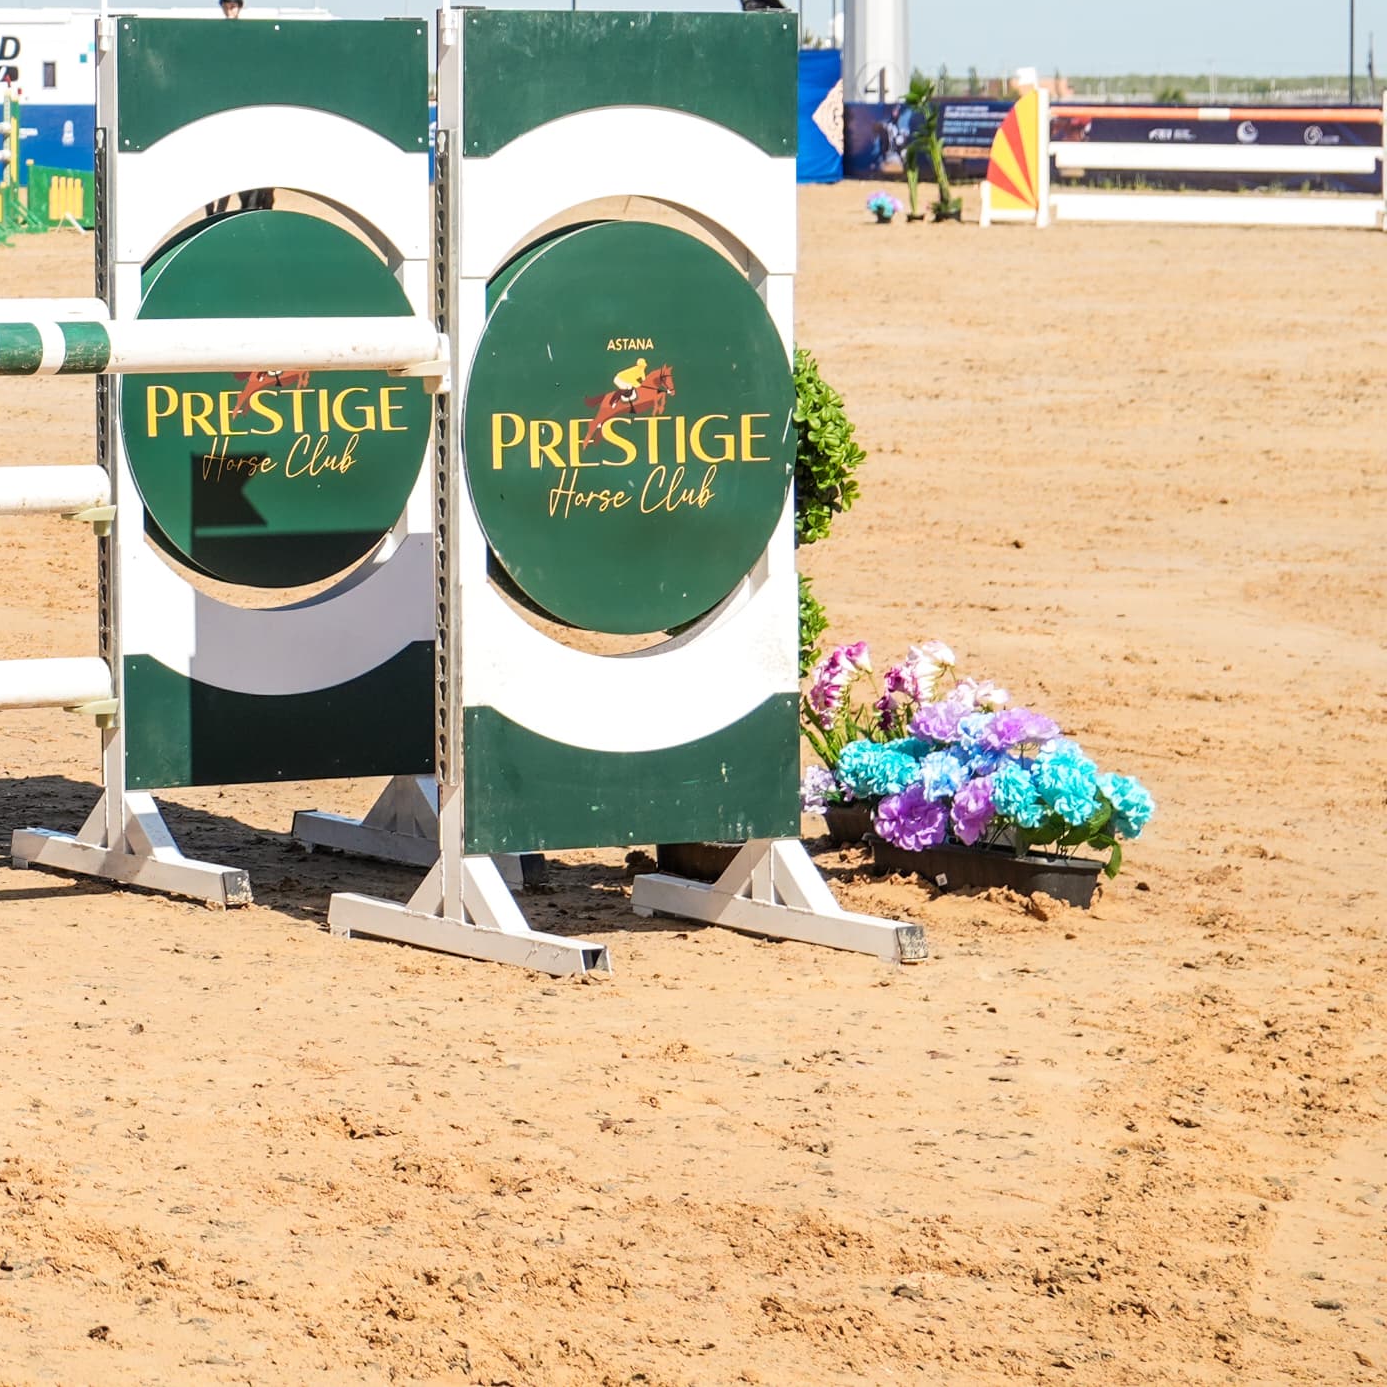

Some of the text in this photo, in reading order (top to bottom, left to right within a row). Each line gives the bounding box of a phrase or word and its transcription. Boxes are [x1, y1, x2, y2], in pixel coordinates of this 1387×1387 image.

[864, 66, 889, 102] 4
[607, 338, 654, 352] ASTANA
[147, 385, 407, 437] PRESTIGE
[202, 433, 359, 483] Horse Club
[491, 413, 770, 470] PRESTIGE
[549, 464, 717, 519] Horse Club
